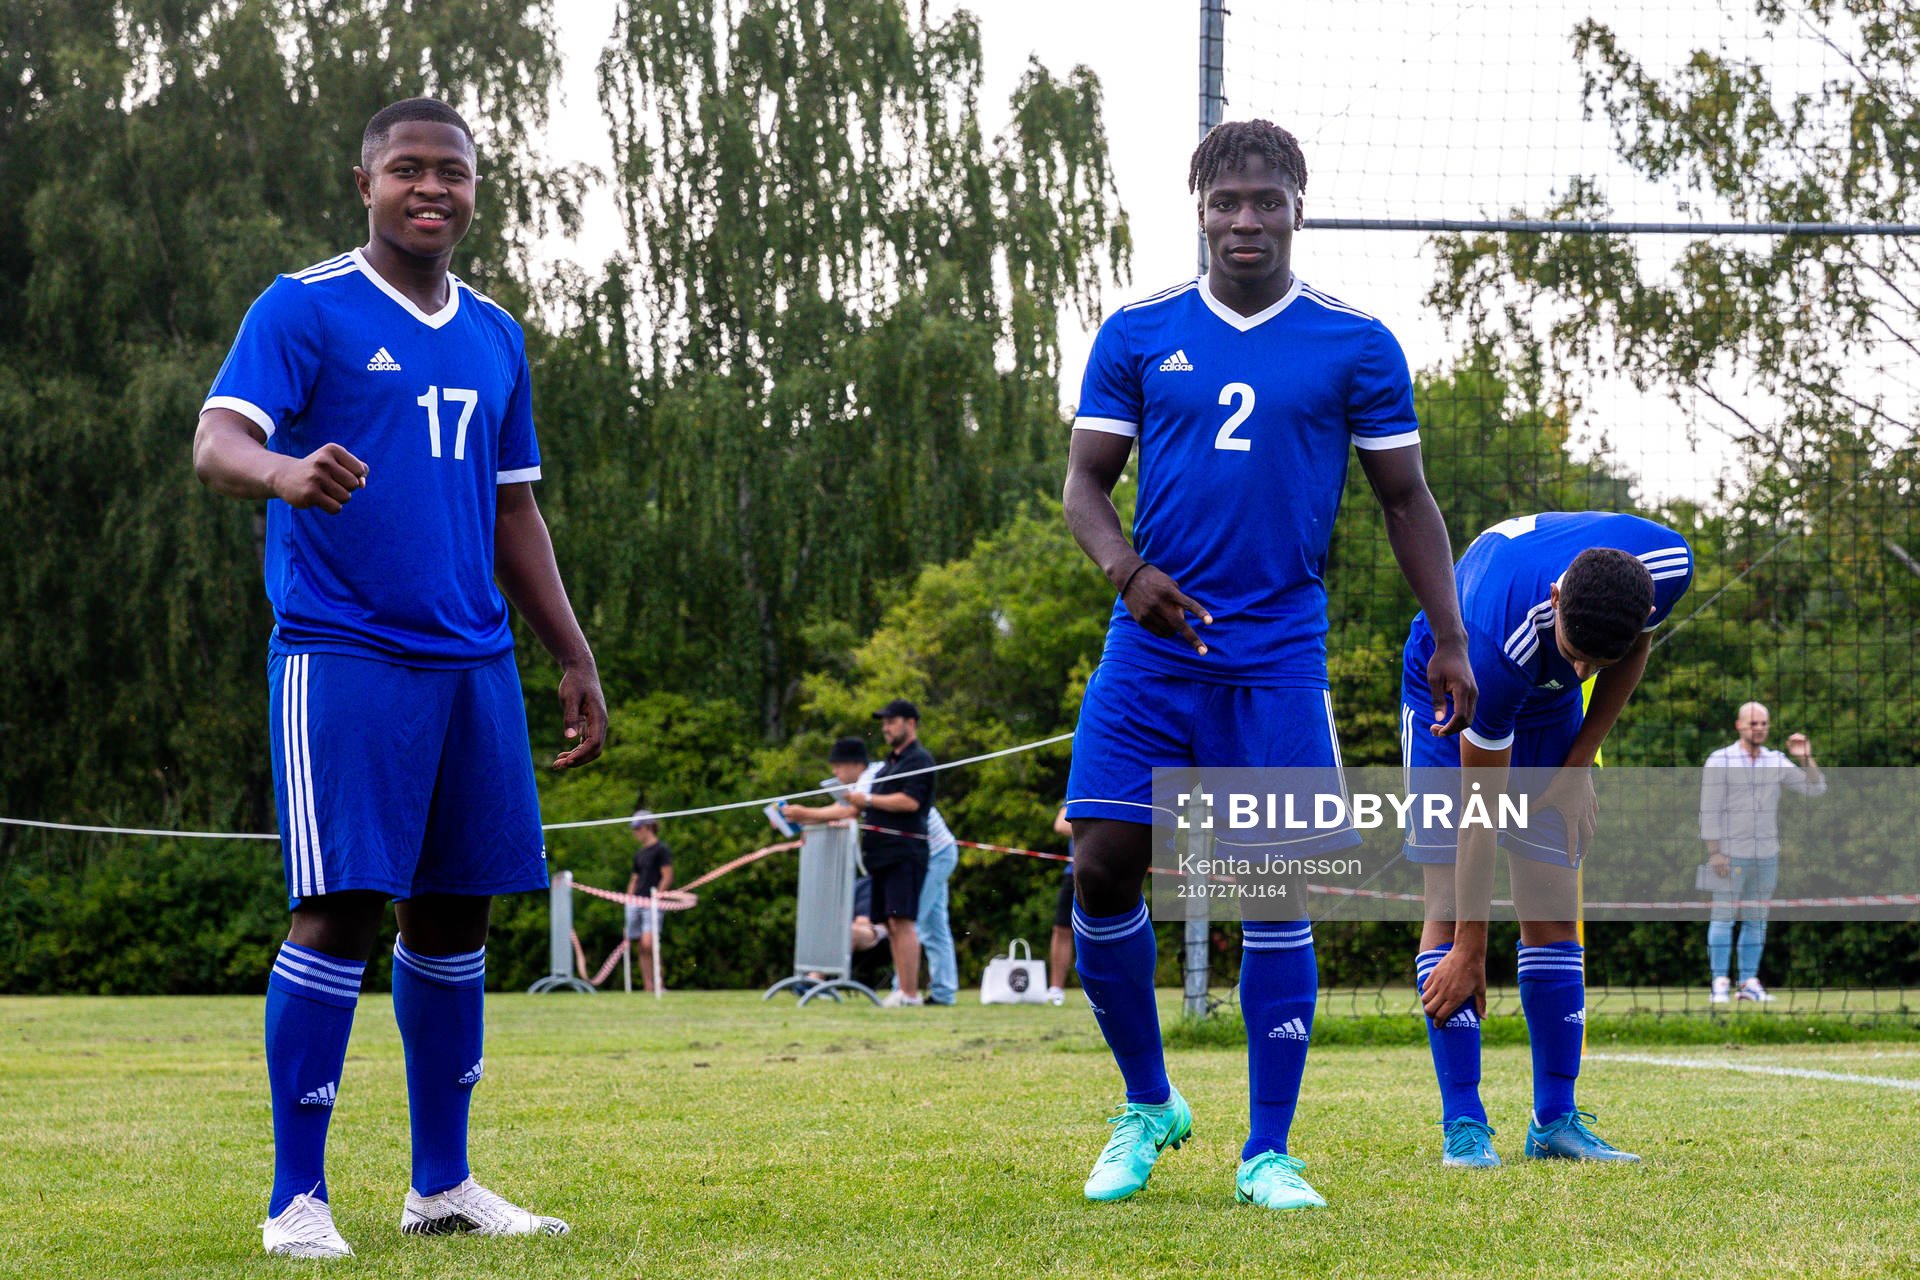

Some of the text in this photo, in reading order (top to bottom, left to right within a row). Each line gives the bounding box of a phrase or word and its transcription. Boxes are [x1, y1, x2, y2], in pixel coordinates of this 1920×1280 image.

[366, 361, 402, 372] adidas
[1159, 362, 1194, 372] adidas
[1214, 382, 1256, 452] 2
[416, 385, 478, 461] 17
[1268, 1031, 1309, 1042] adidas
